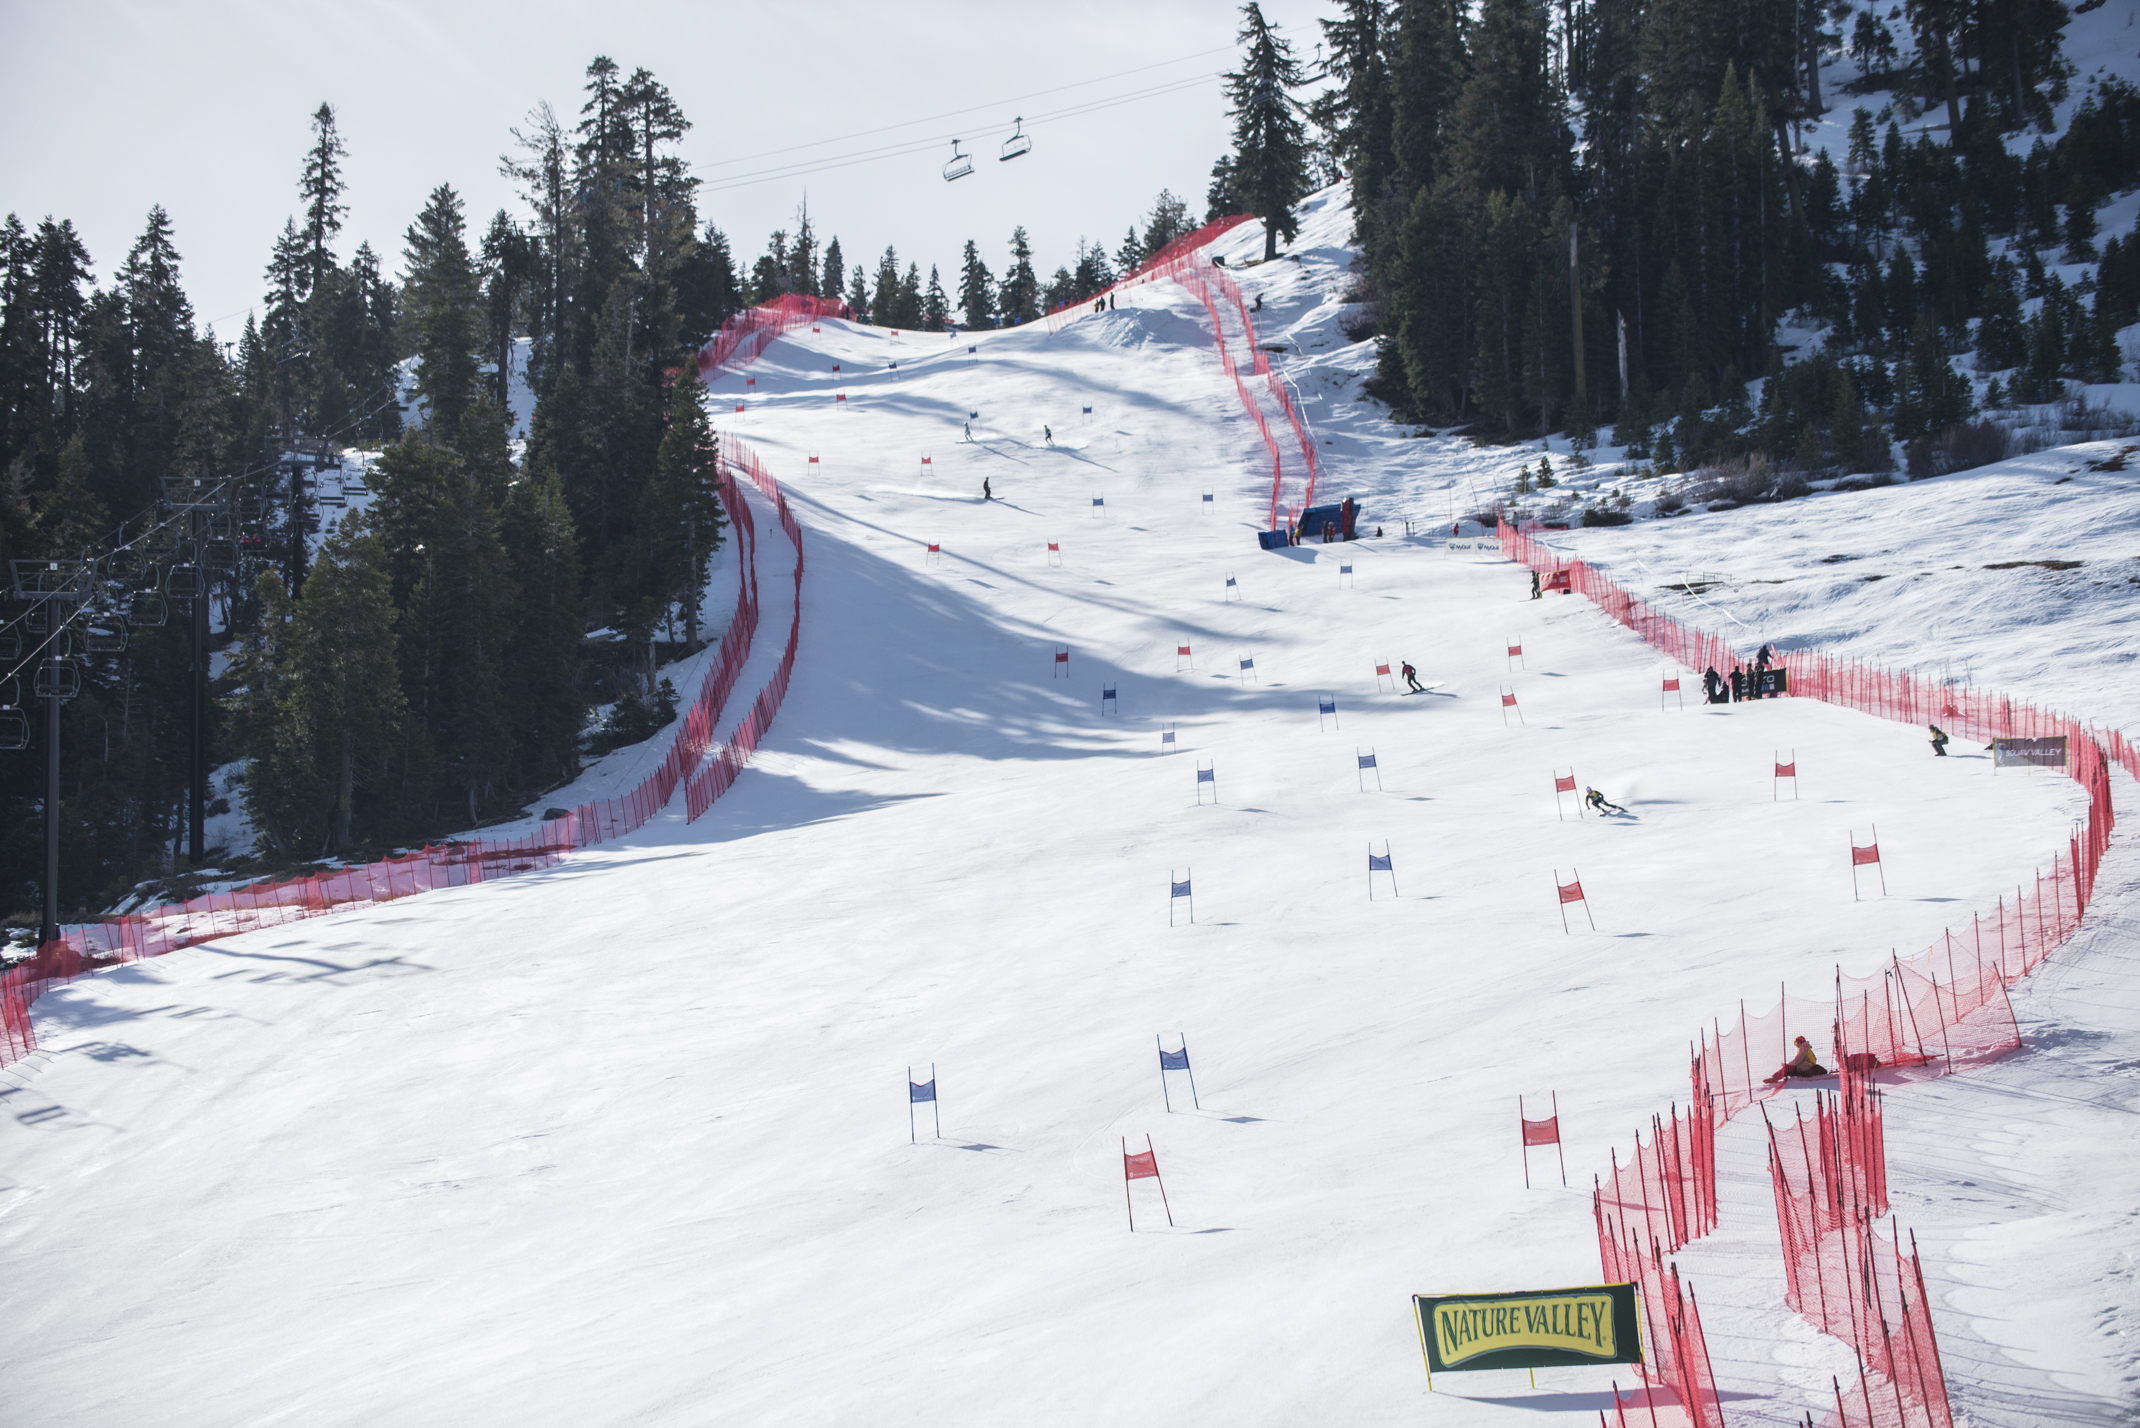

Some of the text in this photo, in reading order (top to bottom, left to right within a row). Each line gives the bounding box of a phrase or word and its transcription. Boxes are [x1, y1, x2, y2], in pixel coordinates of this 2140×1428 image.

[2031, 748, 2062, 756] VALLEY
[1441, 1301, 1606, 1356] NATURE VALLEY
